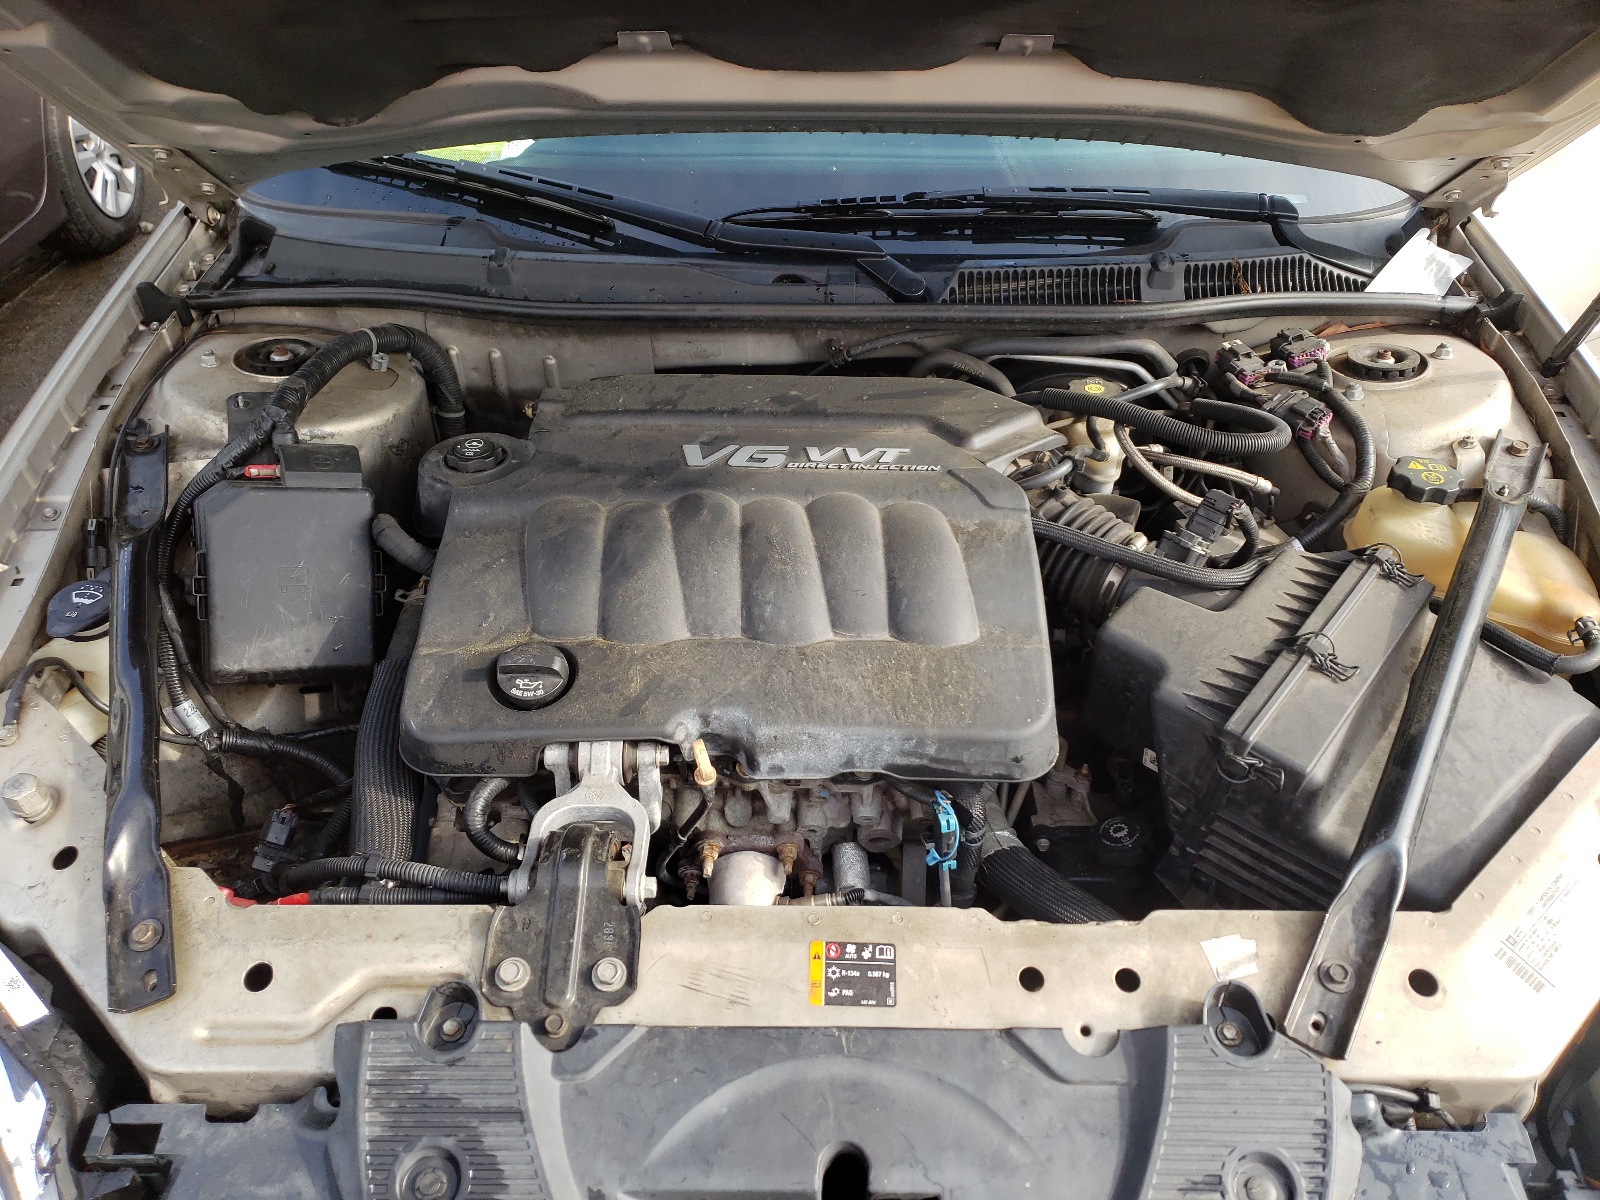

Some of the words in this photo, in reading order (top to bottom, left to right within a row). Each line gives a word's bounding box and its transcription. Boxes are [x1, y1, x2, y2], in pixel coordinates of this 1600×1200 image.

[682, 444, 789, 468] V6
[805, 446, 911, 464] VVT
[787, 462, 849, 470] DIRECT
[851, 463, 942, 472] INJECTION
[511, 688, 523, 697] SAE
[523, 689, 544, 697] 5W-30
[841, 970, 860, 978] R-134a
